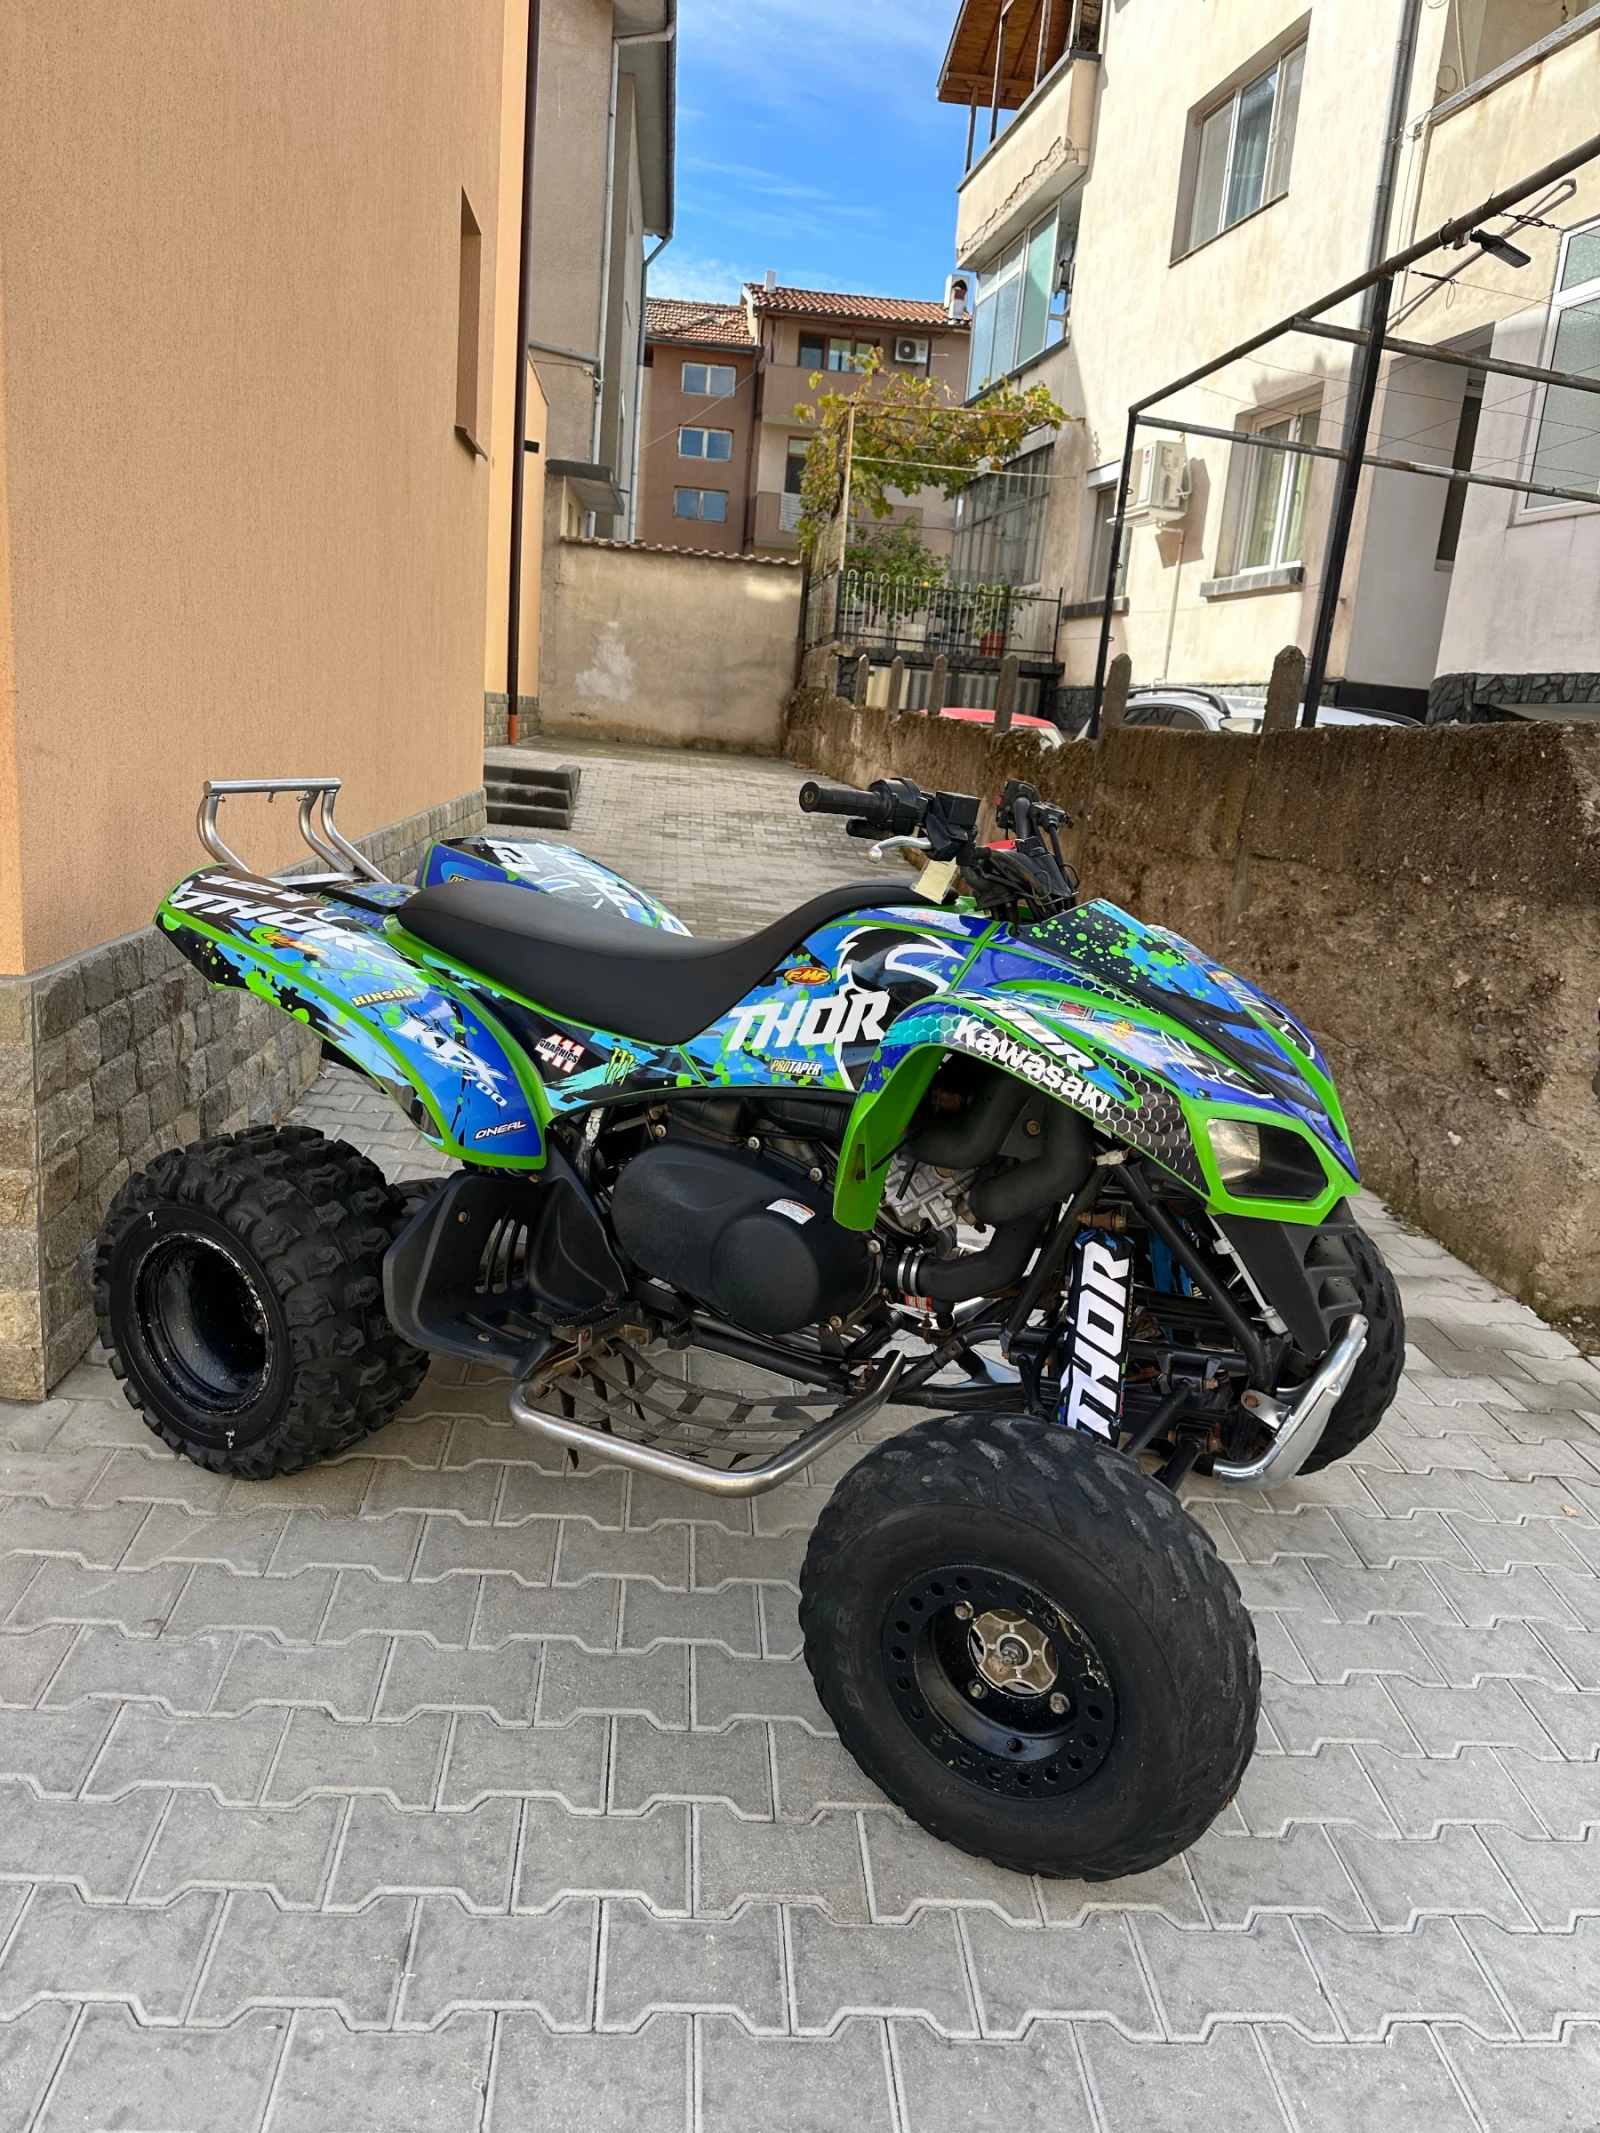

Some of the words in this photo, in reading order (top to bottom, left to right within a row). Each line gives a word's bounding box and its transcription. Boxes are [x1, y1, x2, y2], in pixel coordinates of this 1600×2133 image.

[170, 889, 376, 952] THOR
[351, 988, 415, 1006] HINSON
[785, 968, 831, 982] FMF
[539, 1038, 579, 1064] GRAPHICS
[728, 990, 891, 1051] THOR
[389, 1015, 508, 1094] KFX
[953, 1016, 1110, 1114] Kawasaki
[474, 1120, 527, 1140] ONEAL
[1067, 1241, 1130, 1440] THOR
